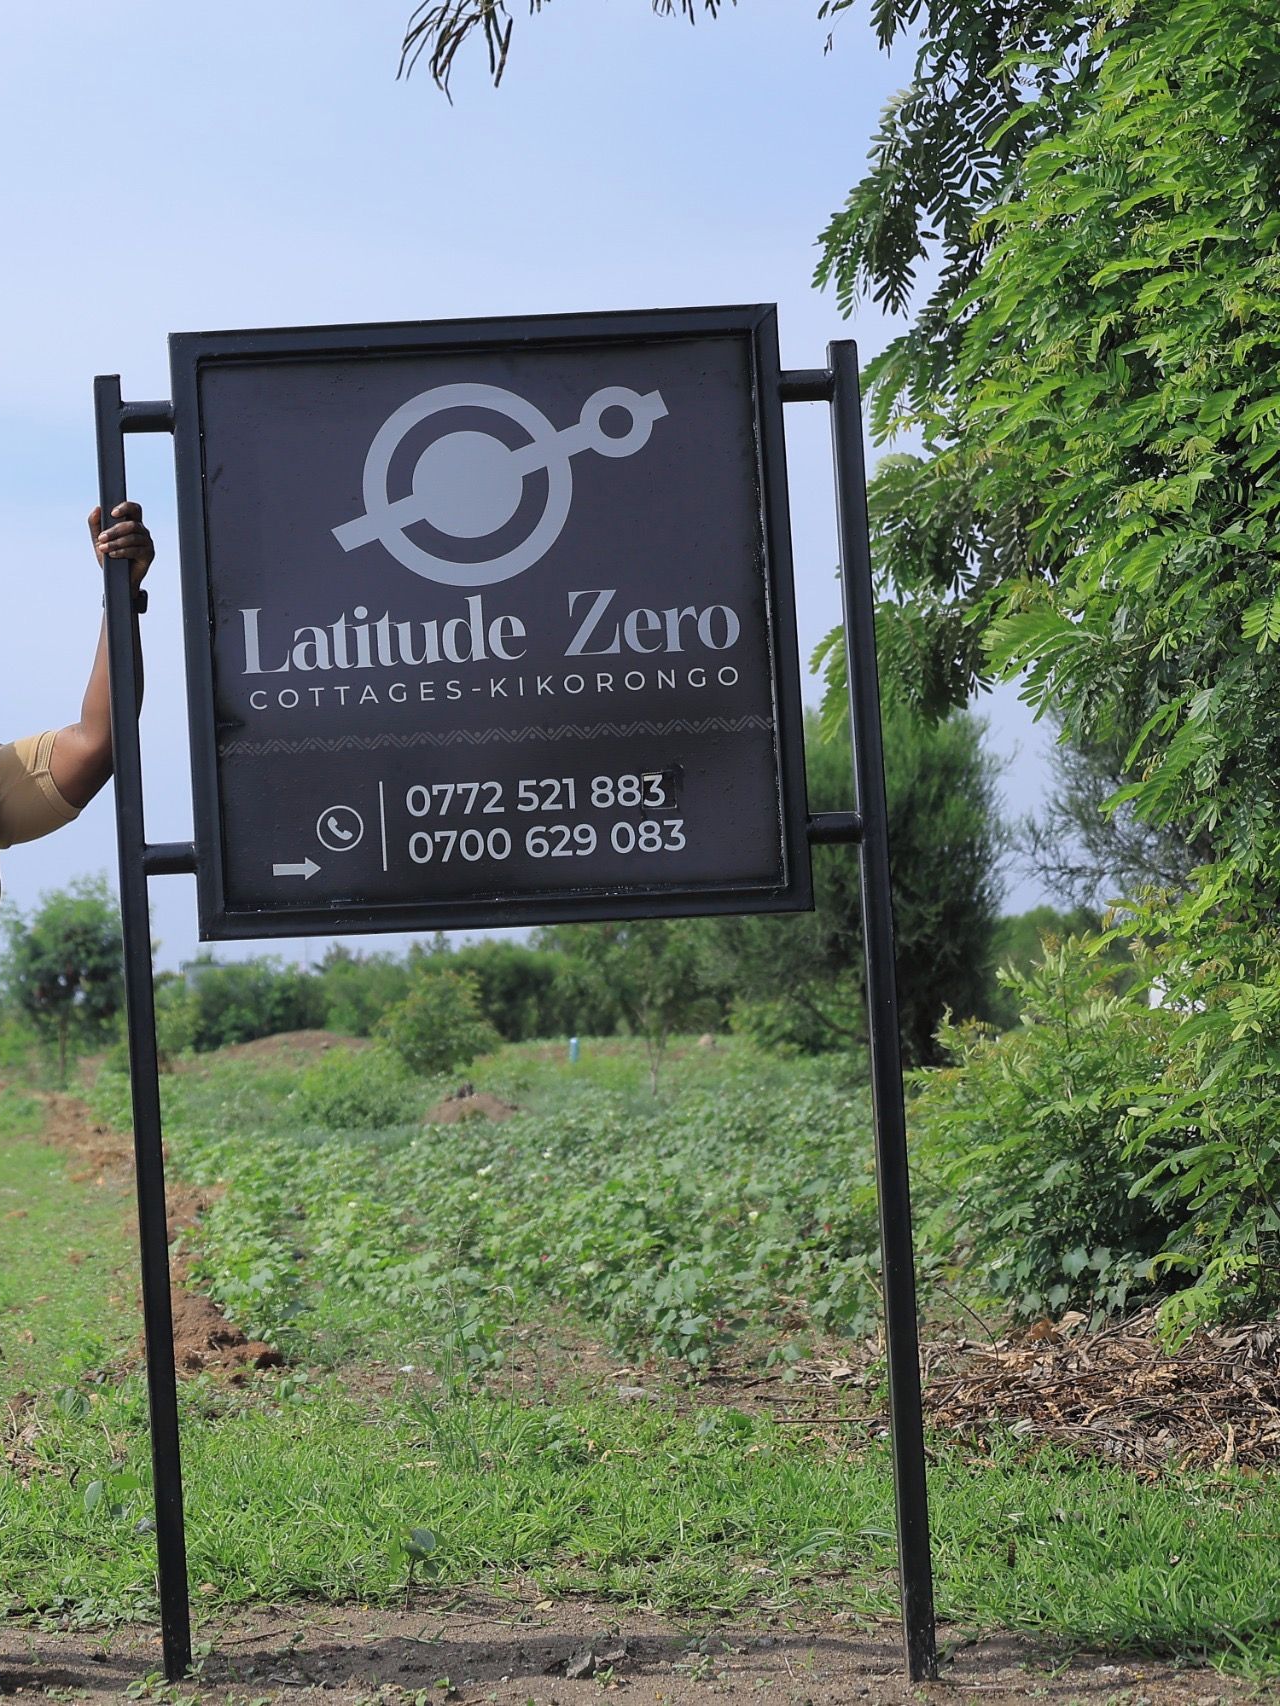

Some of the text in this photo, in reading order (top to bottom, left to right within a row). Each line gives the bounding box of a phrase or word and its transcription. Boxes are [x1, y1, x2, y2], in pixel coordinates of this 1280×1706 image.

[239, 589, 740, 675] Latitude Zero
[250, 665, 740, 711] COTTAGES-KIKORONGO
[406, 774, 667, 818] 0772 521 883
[408, 820, 687, 864] 0700 629 083
